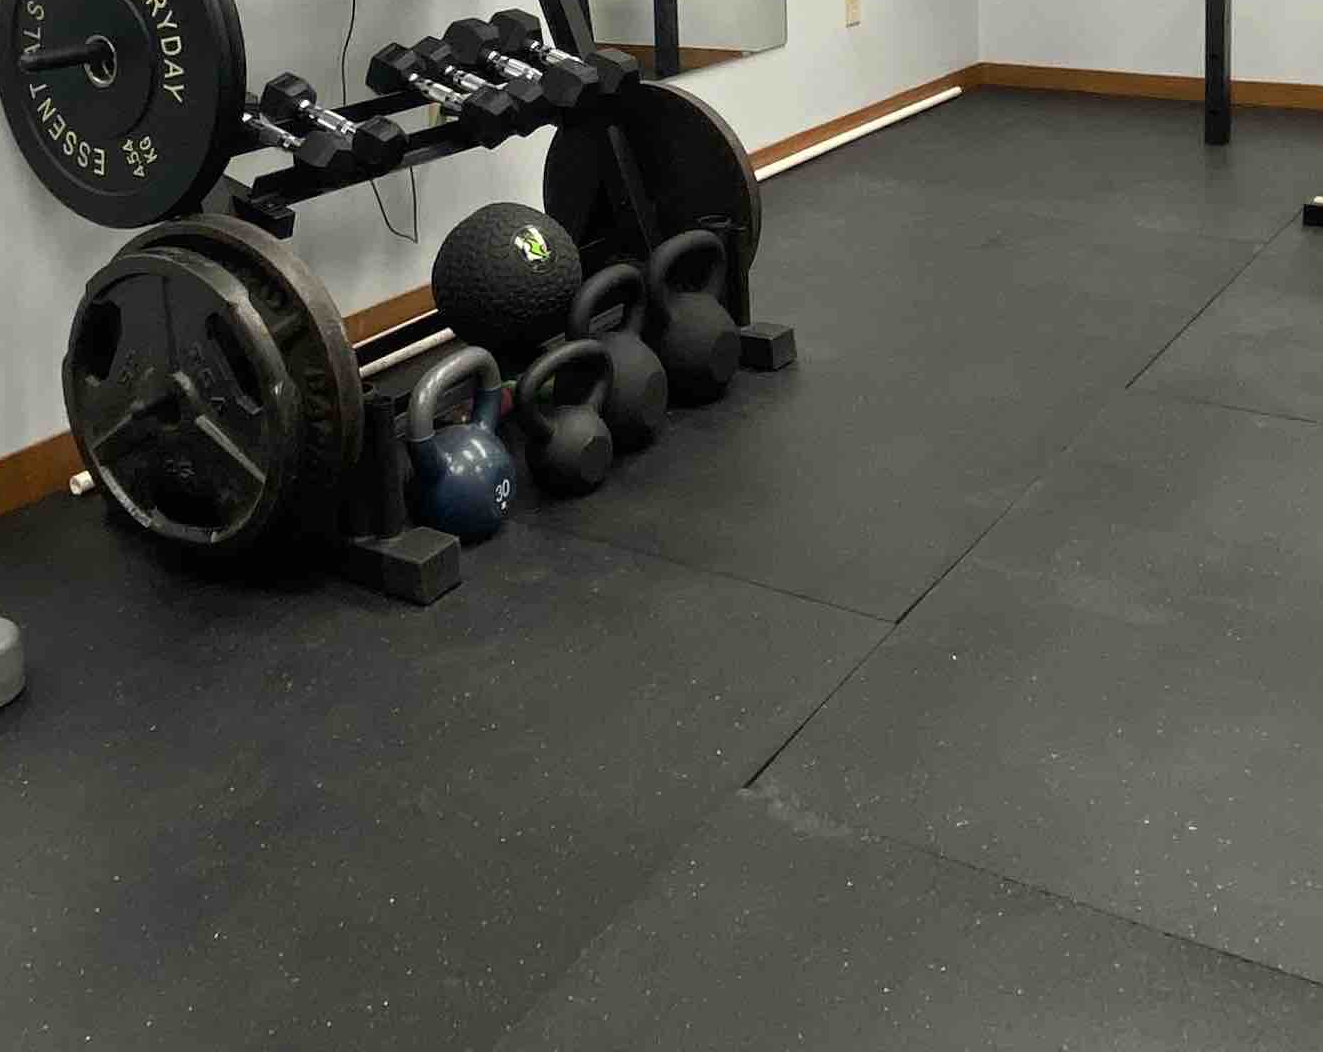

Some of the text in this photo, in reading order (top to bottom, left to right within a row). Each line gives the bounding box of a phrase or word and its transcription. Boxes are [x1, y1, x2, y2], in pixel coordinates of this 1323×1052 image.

[23, 0, 106, 176] ESSENTALS
[139, 135, 157, 164] KG
[495, 478, 511, 503] 30
